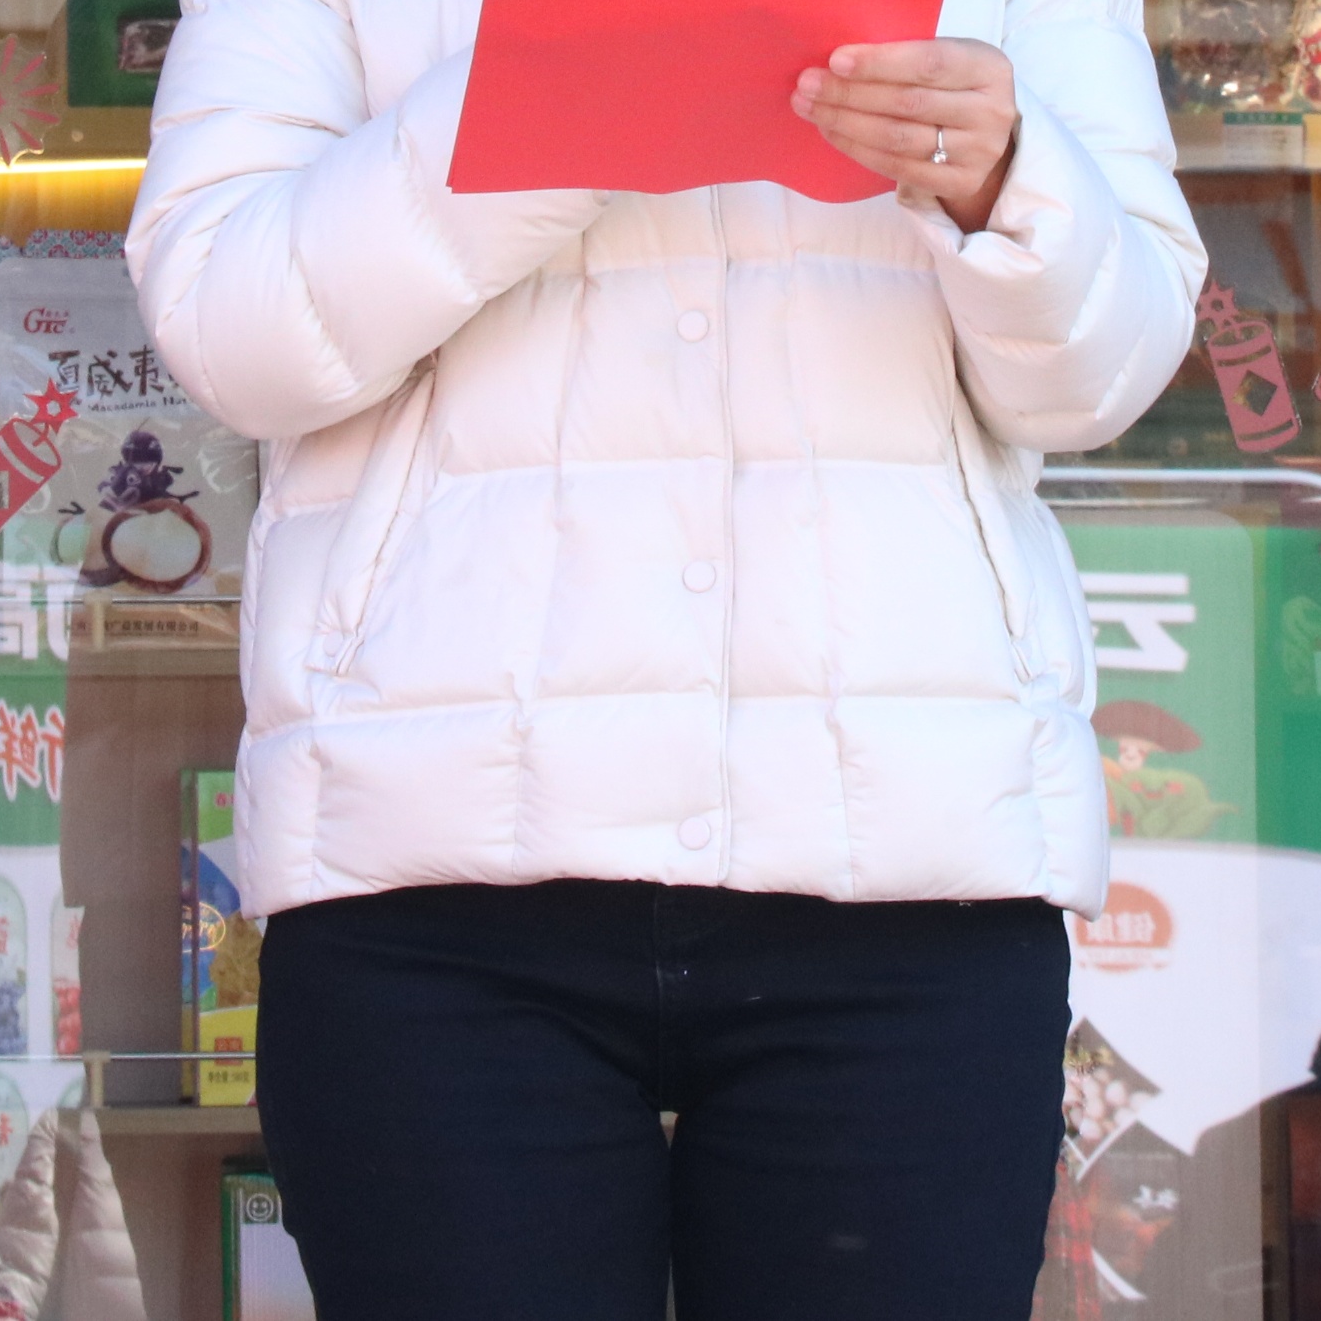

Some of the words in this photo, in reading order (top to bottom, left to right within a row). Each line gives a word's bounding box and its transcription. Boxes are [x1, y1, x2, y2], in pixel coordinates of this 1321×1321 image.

[48, 343, 179, 406] 夏威夷
[163, 396, 191, 407] Nut
